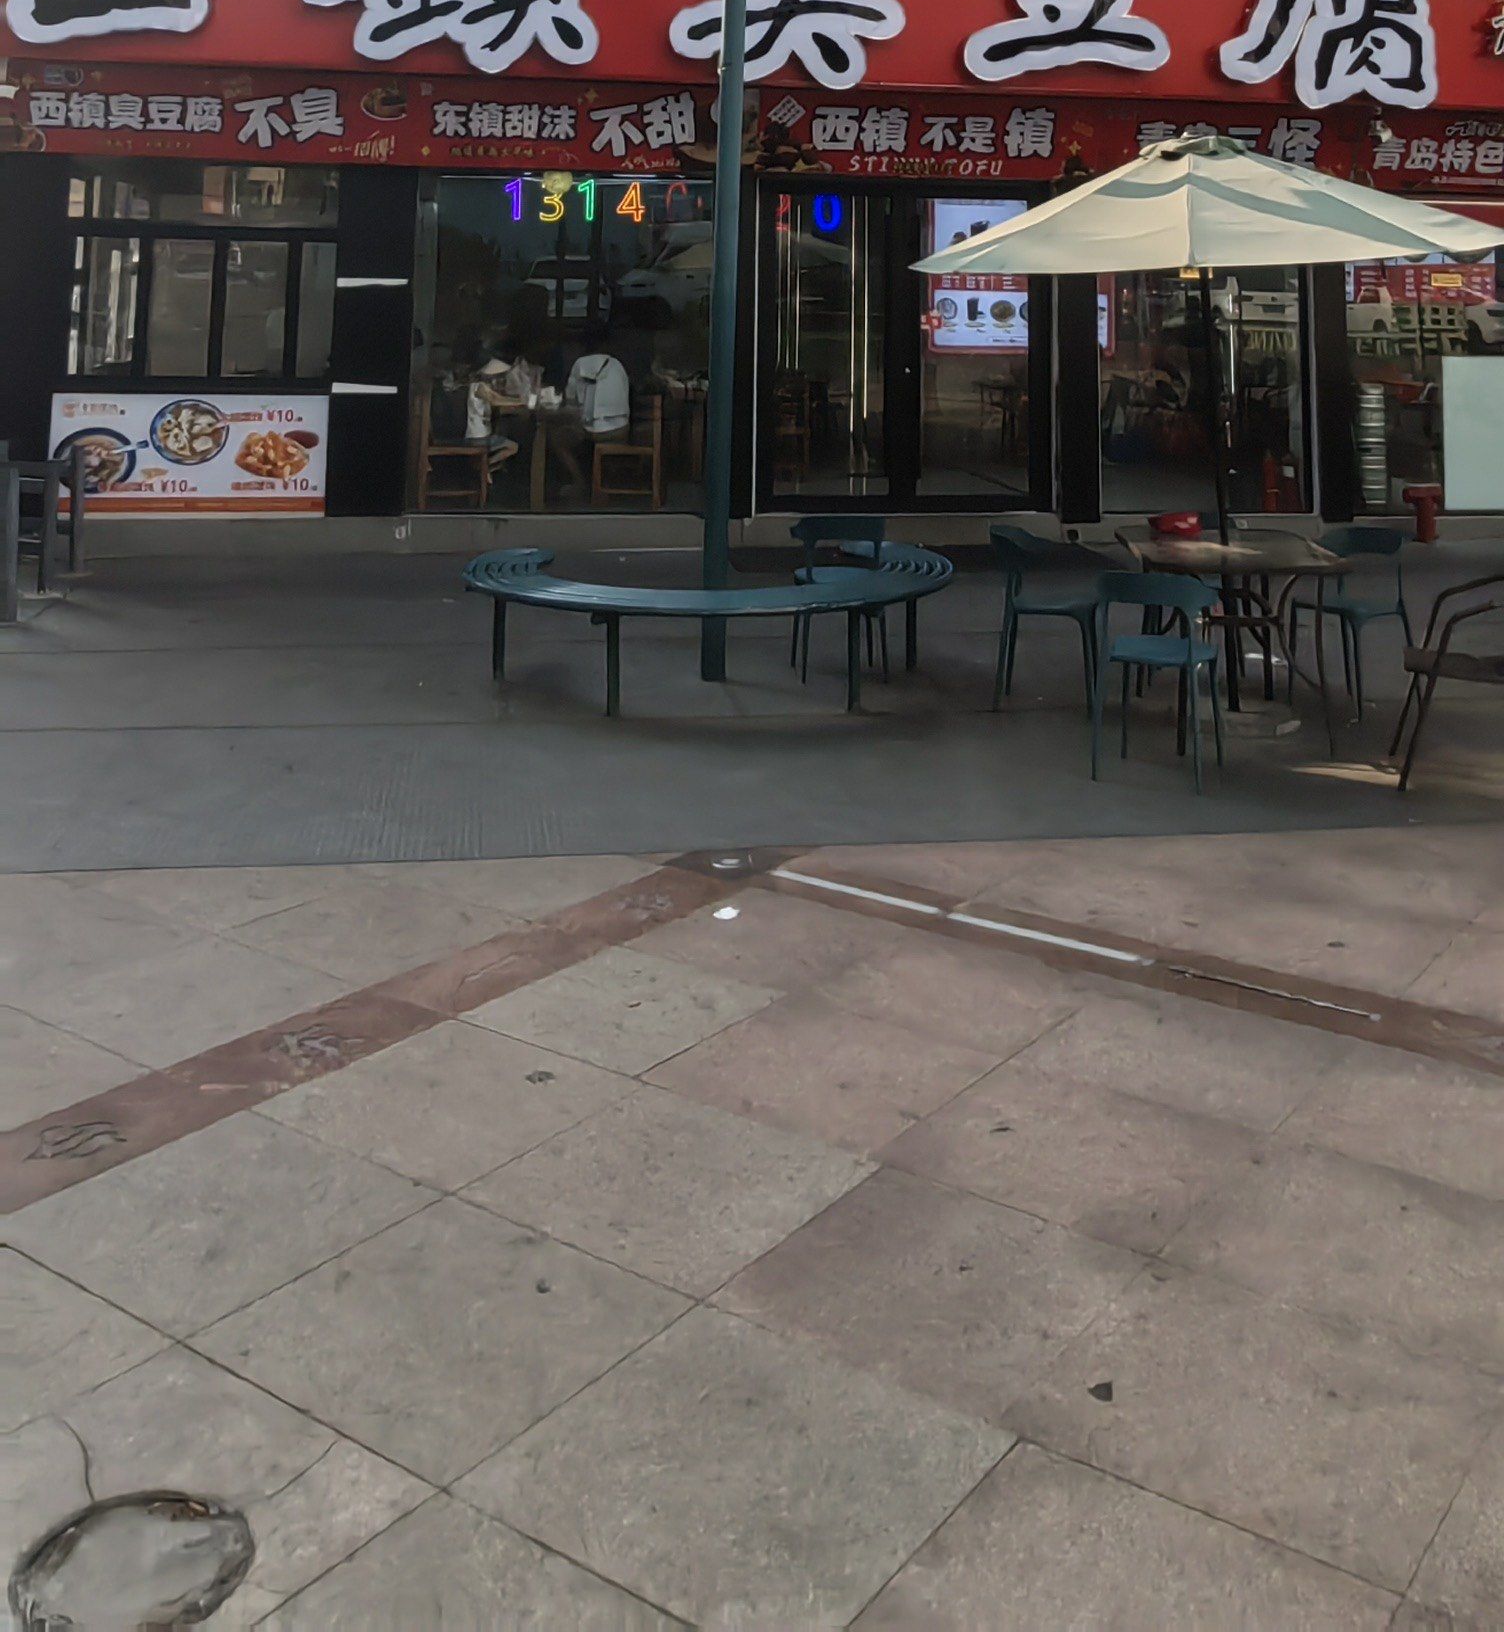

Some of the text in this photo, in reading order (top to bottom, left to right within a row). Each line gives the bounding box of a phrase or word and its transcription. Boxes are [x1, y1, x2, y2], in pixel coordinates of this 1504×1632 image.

[29, 90, 224, 134] 西镇臭豆腐
[234, 86, 345, 148] 不臭
[432, 91, 697, 157] 东镇甜沫 不甜
[848, 154, 938, 175] STI
[1373, 136, 1504, 174] 青岛特色
